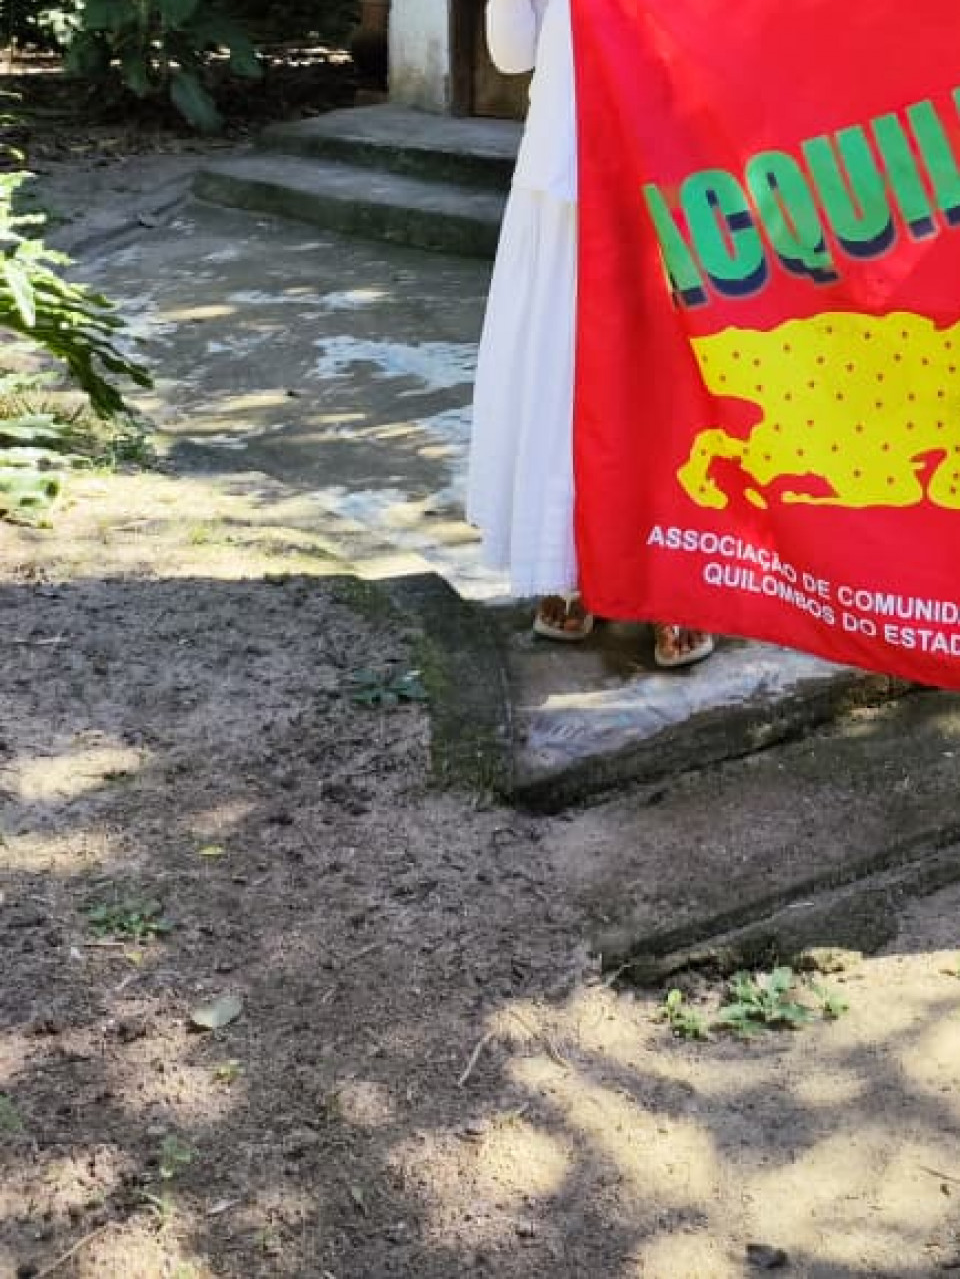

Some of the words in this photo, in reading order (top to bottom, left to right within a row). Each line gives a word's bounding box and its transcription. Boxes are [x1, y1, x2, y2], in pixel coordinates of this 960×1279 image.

[704, 562, 835, 625] QUILOMBOS
[842, 611, 877, 636] DO
[802, 572, 831, 600] DE
